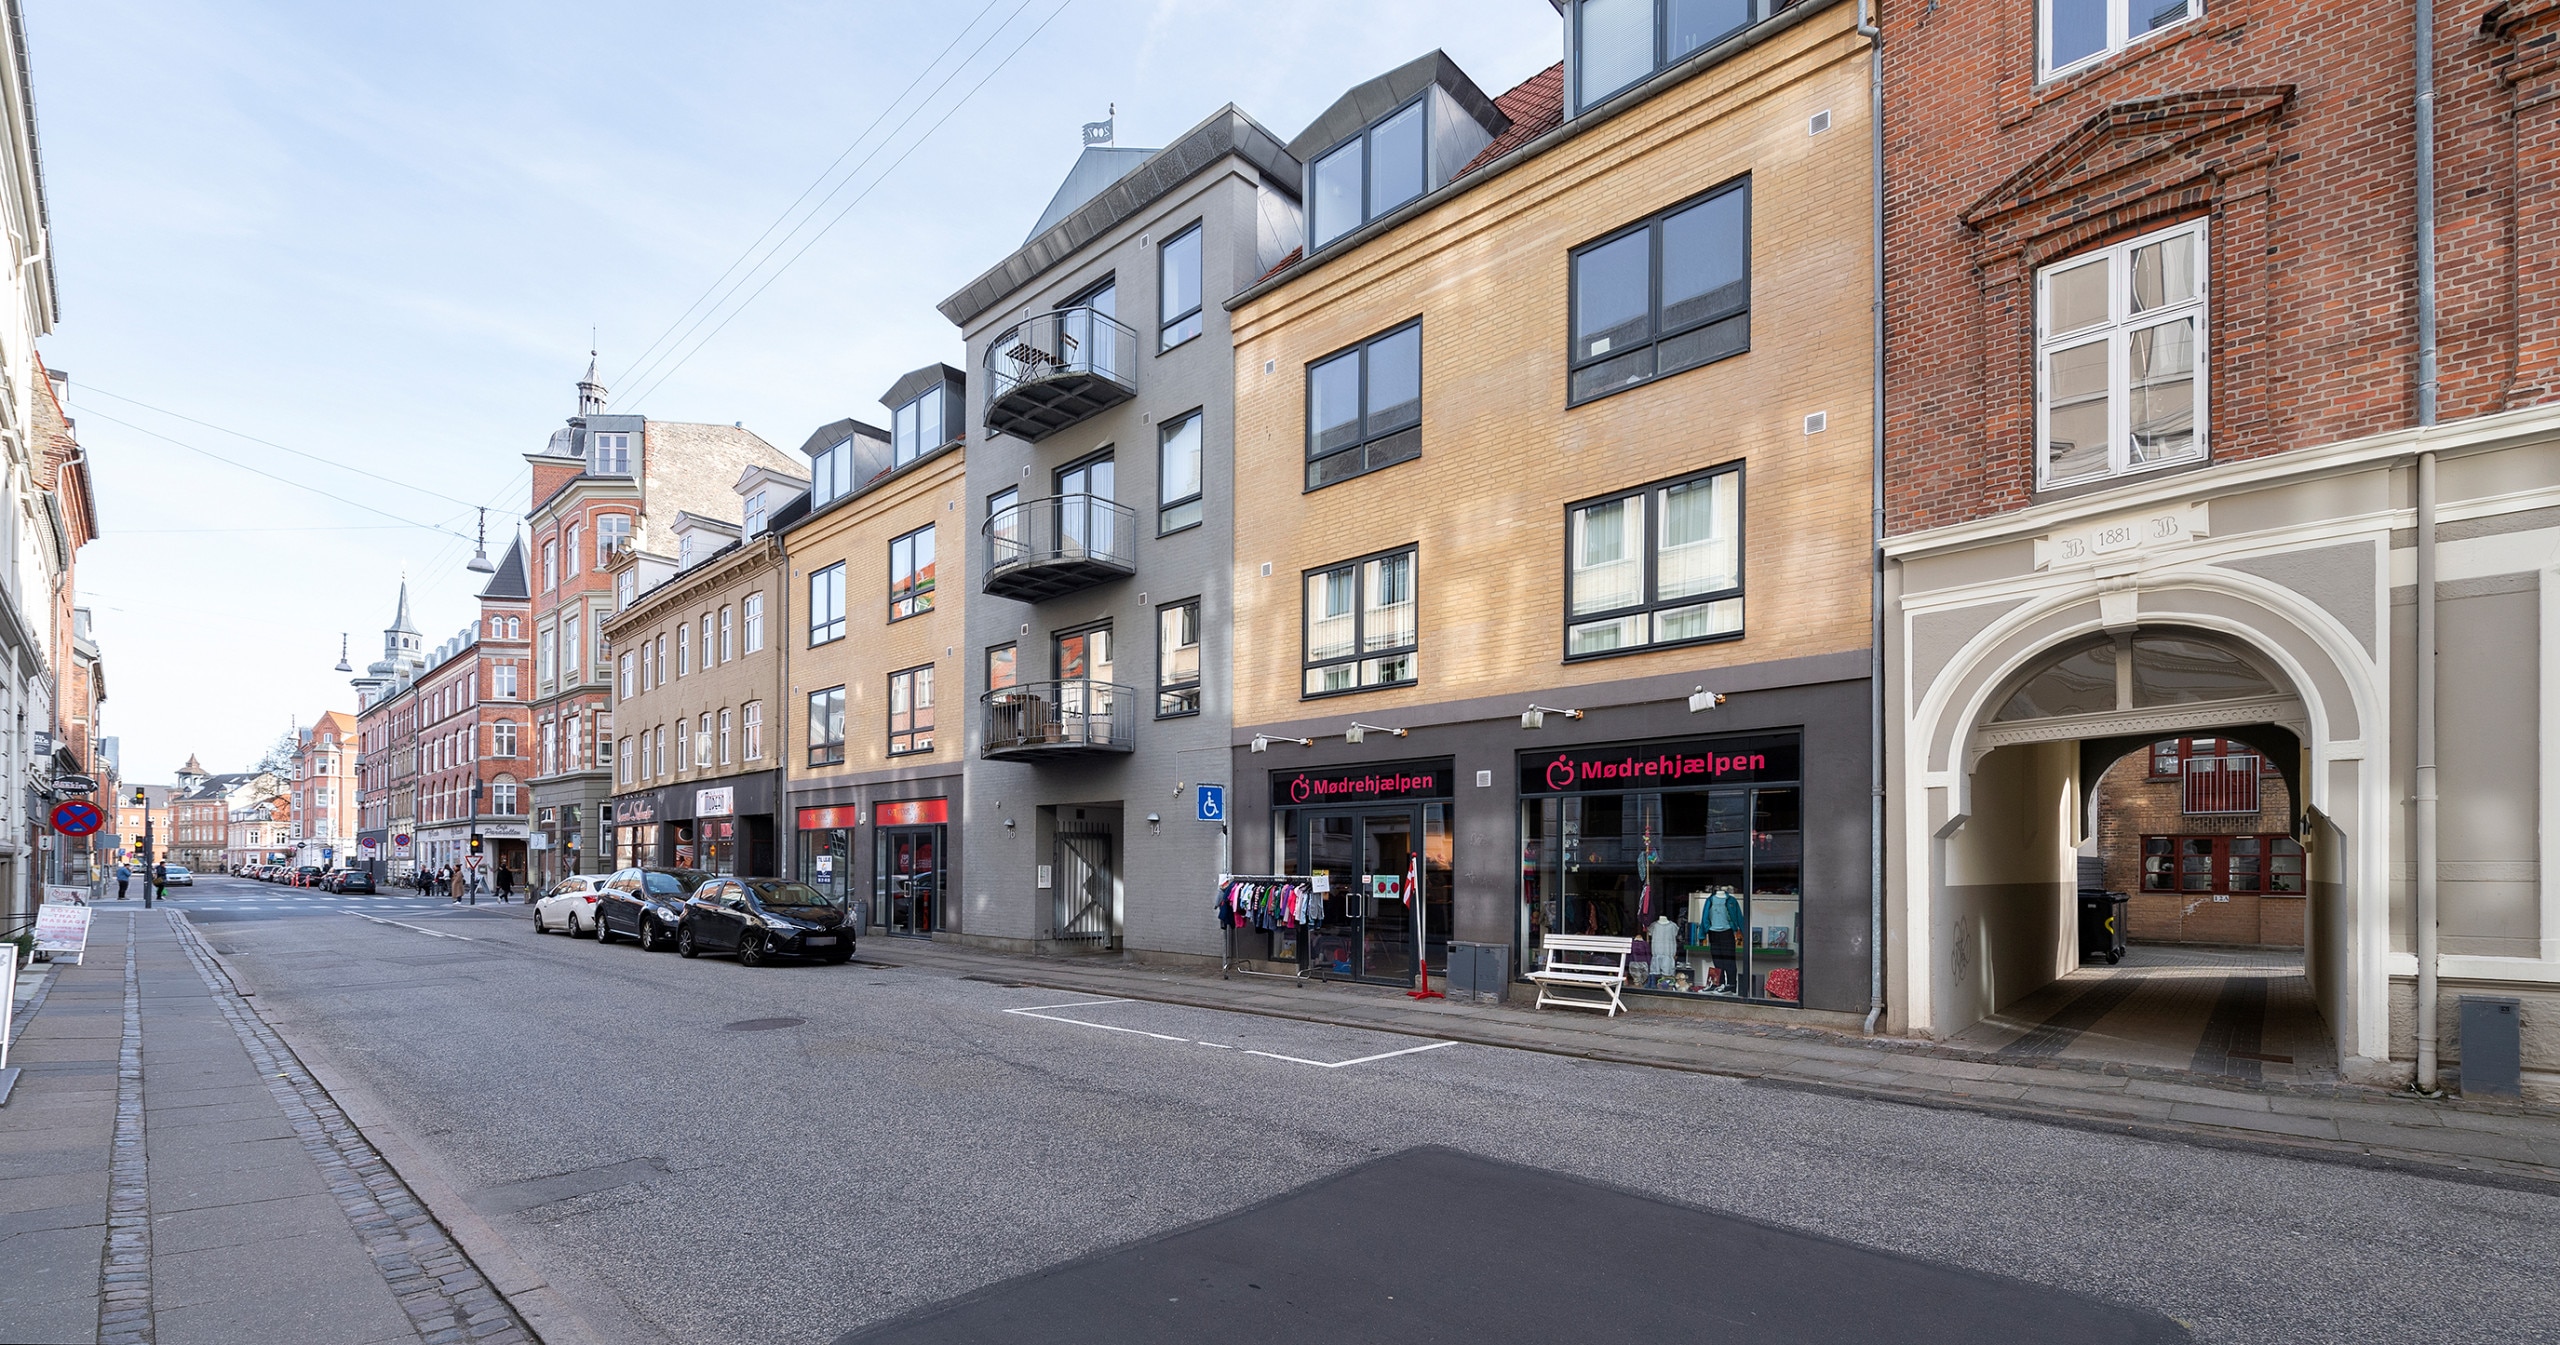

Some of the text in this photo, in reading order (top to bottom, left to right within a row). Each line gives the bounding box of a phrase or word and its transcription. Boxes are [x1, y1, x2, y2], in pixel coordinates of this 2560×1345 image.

[2099, 527, 2130, 546] 1881
[1581, 752, 1765, 779] Mødrehjælpen
[1314, 773, 1433, 795] Mødrehjælpen
[1150, 824, 1160, 835] 14
